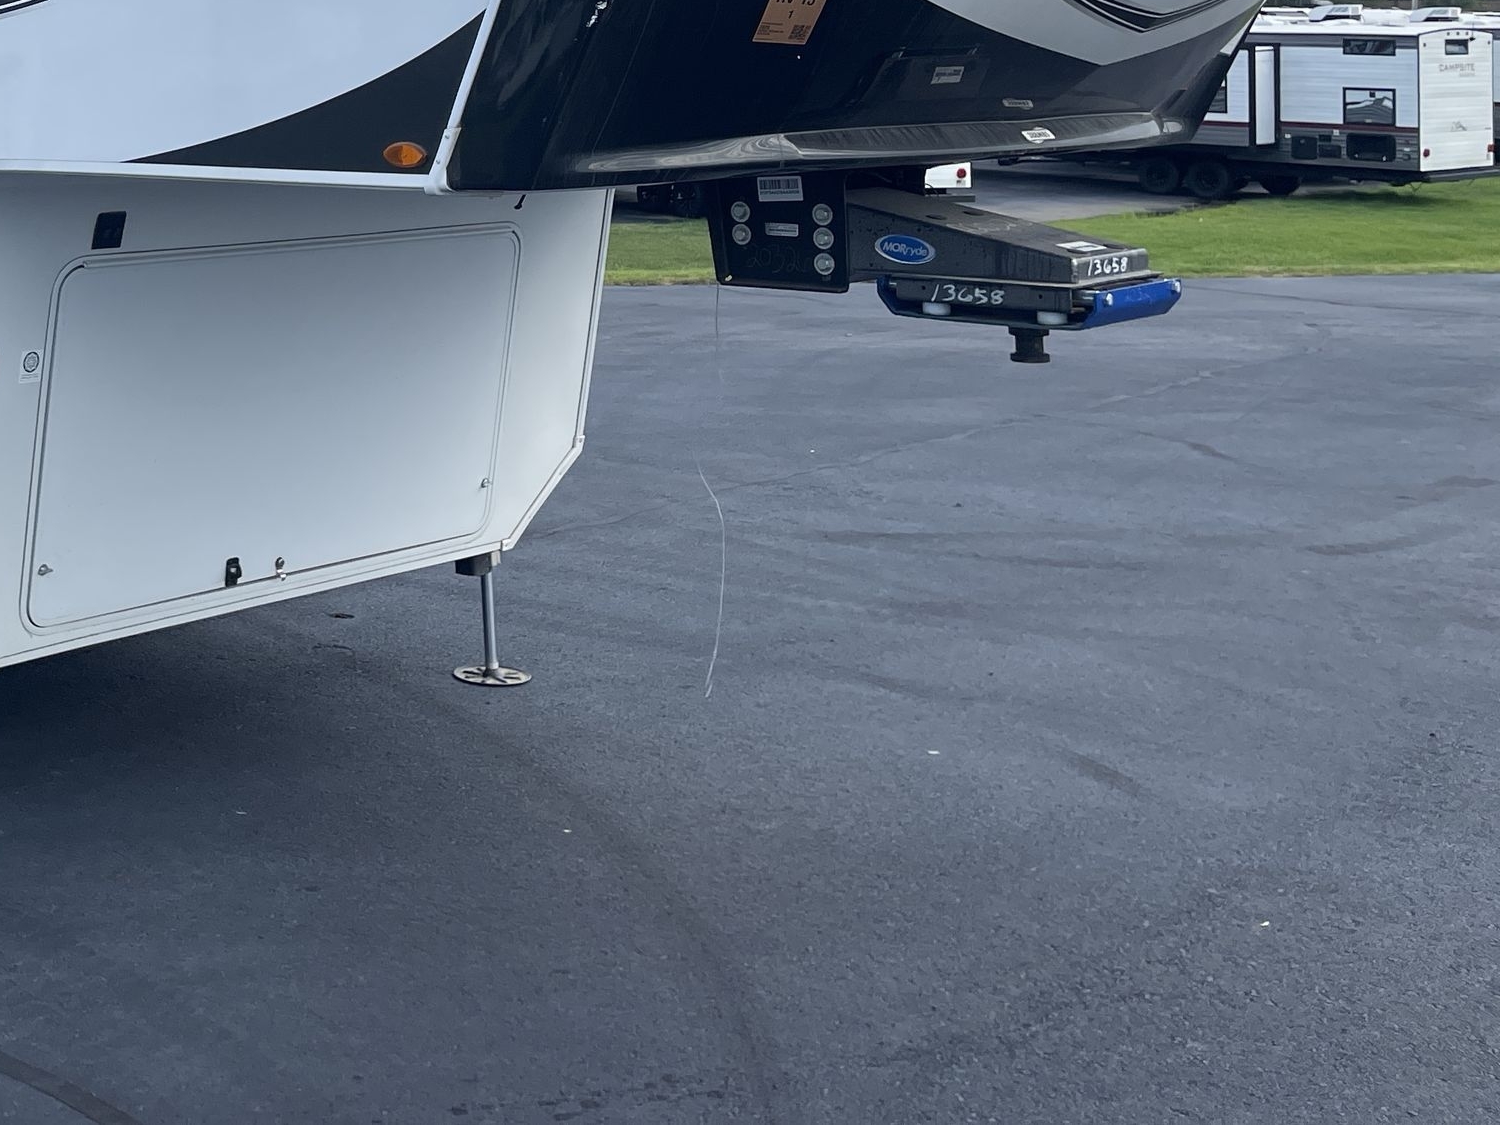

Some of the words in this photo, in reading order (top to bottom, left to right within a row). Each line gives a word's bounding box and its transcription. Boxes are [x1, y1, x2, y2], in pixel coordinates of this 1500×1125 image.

[788, 10, 794, 19] 1
[1087, 256, 1128, 276] 13658
[931, 283, 1005, 305] 13658
